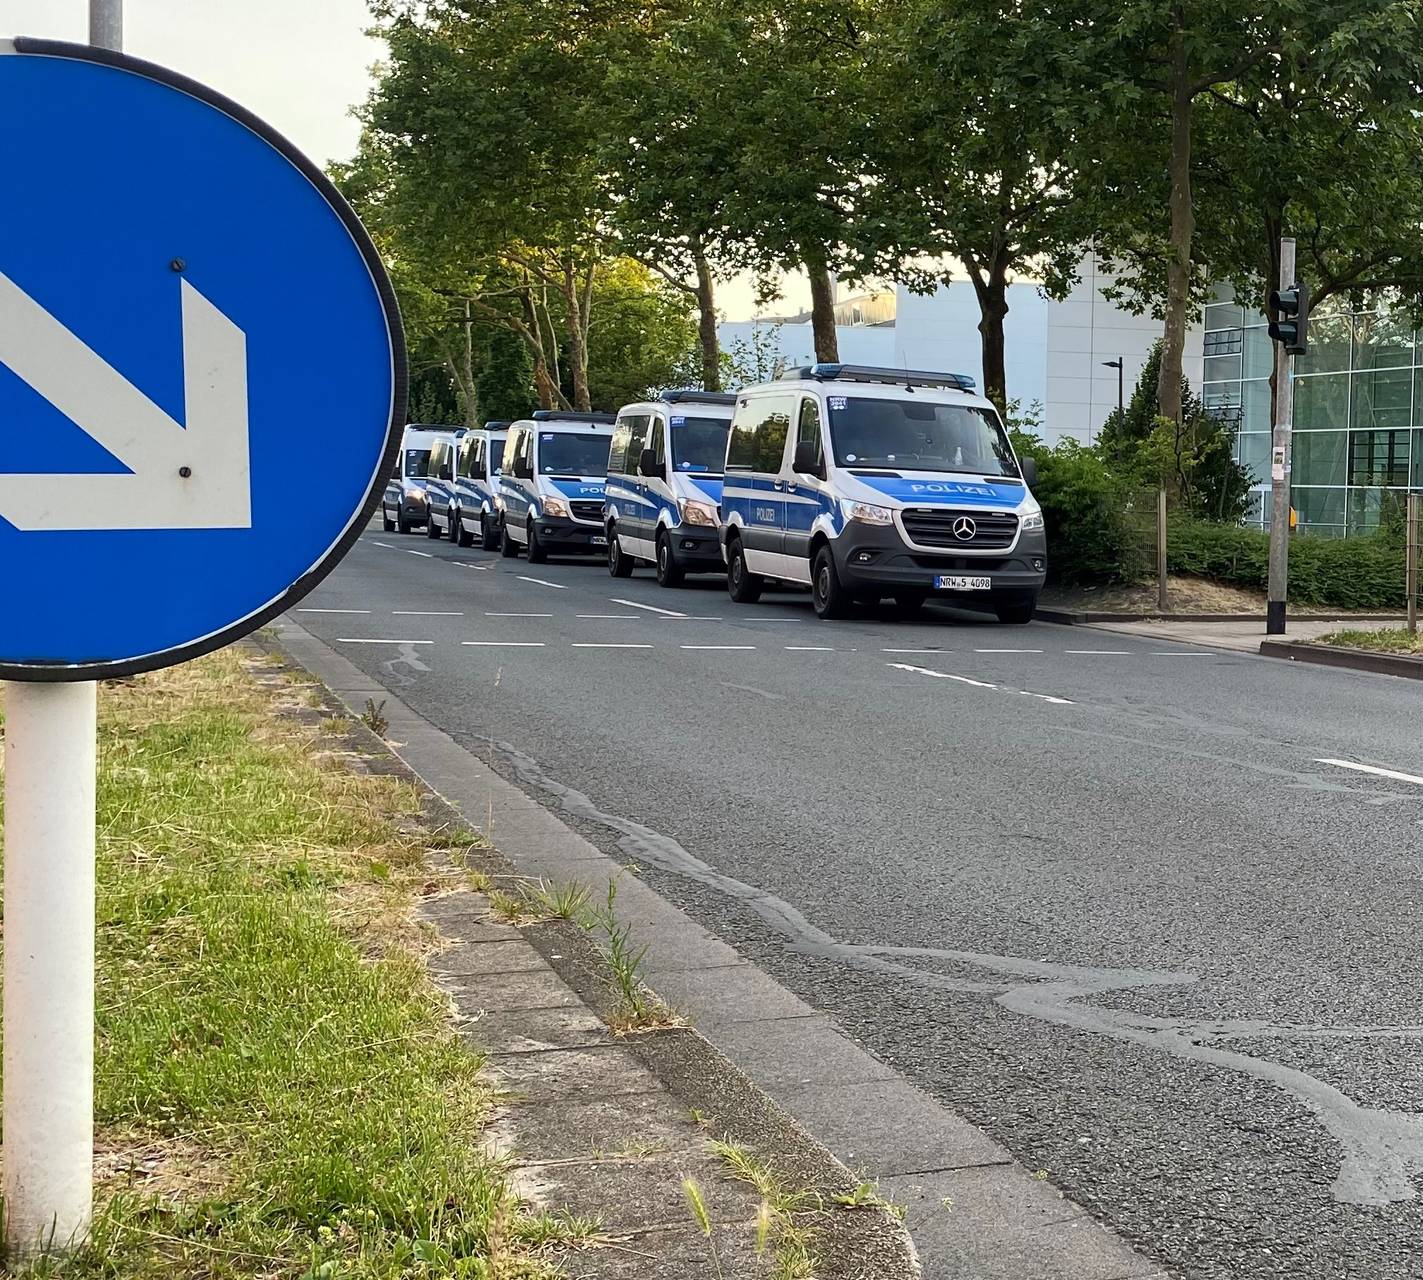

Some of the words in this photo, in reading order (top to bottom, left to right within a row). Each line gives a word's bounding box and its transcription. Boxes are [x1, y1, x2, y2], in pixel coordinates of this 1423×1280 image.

[911, 484, 996, 497] POLIZEI
[940, 577, 957, 587] NRW
[970, 578, 990, 588] 4098
